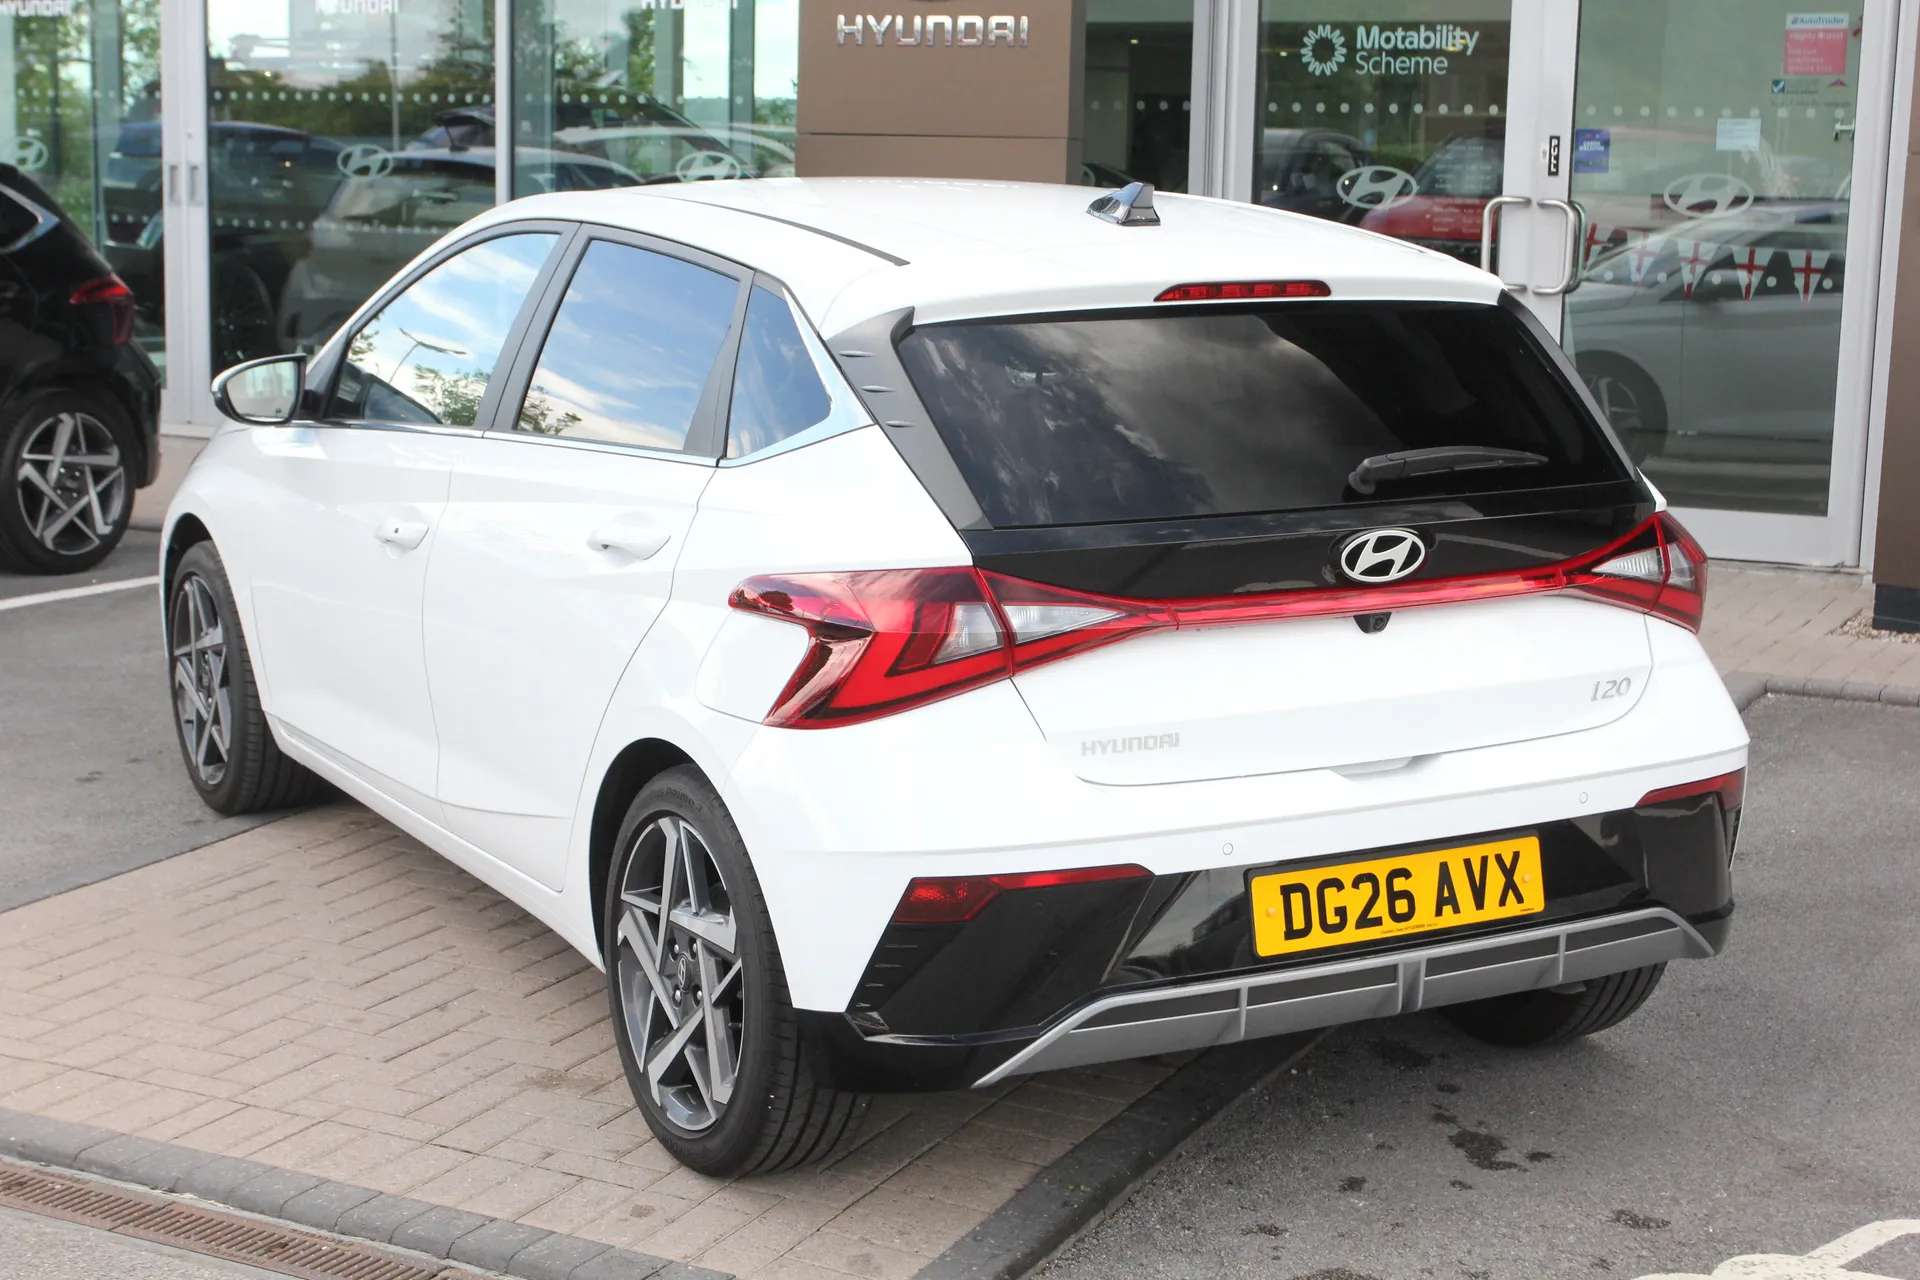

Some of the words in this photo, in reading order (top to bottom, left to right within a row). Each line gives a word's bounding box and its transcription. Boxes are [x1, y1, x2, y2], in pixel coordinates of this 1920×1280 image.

[314, 0, 400, 15] UNDAI
[836, 13, 1030, 48] HYUNDAI
[1355, 23, 1480, 57] Motability
[1355, 50, 1449, 76] Scheme
[1080, 731, 1180, 757] HYUNDAI
[1279, 867, 1416, 941] DG26
[1434, 850, 1525, 918] AVX
